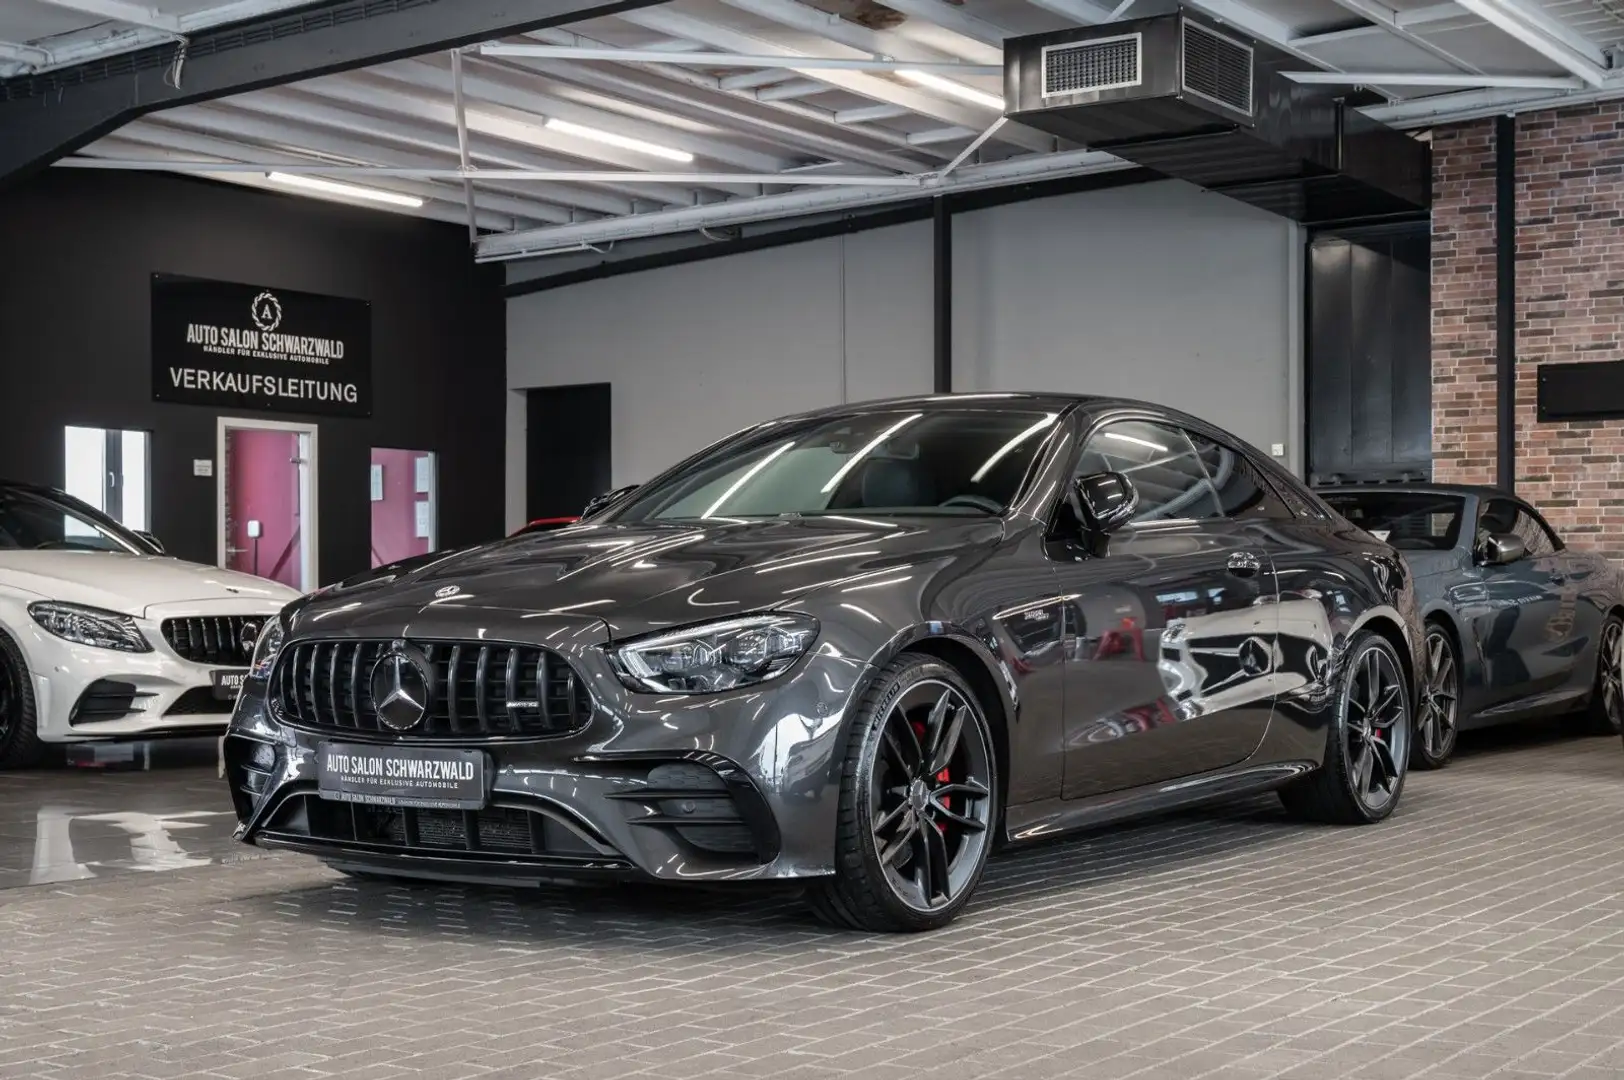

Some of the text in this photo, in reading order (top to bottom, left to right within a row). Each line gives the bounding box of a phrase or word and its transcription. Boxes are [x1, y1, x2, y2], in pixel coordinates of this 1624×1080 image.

[261, 304, 272, 319] A
[187, 323, 344, 359] AUTO SALON SCHWARZWALD
[203, 344, 330, 365] HÄNDLER FÜR EXKLUSIVE AUTOMOBILE
[169, 367, 358, 403] VERKAUFSLEITUNG
[221, 675, 239, 686] AUTO
[326, 753, 475, 781] AUTO SALON SCHWARZWALD
[341, 775, 459, 789] HÄNDLER FÜR EXKLUSIVE AUTOMOBILE
